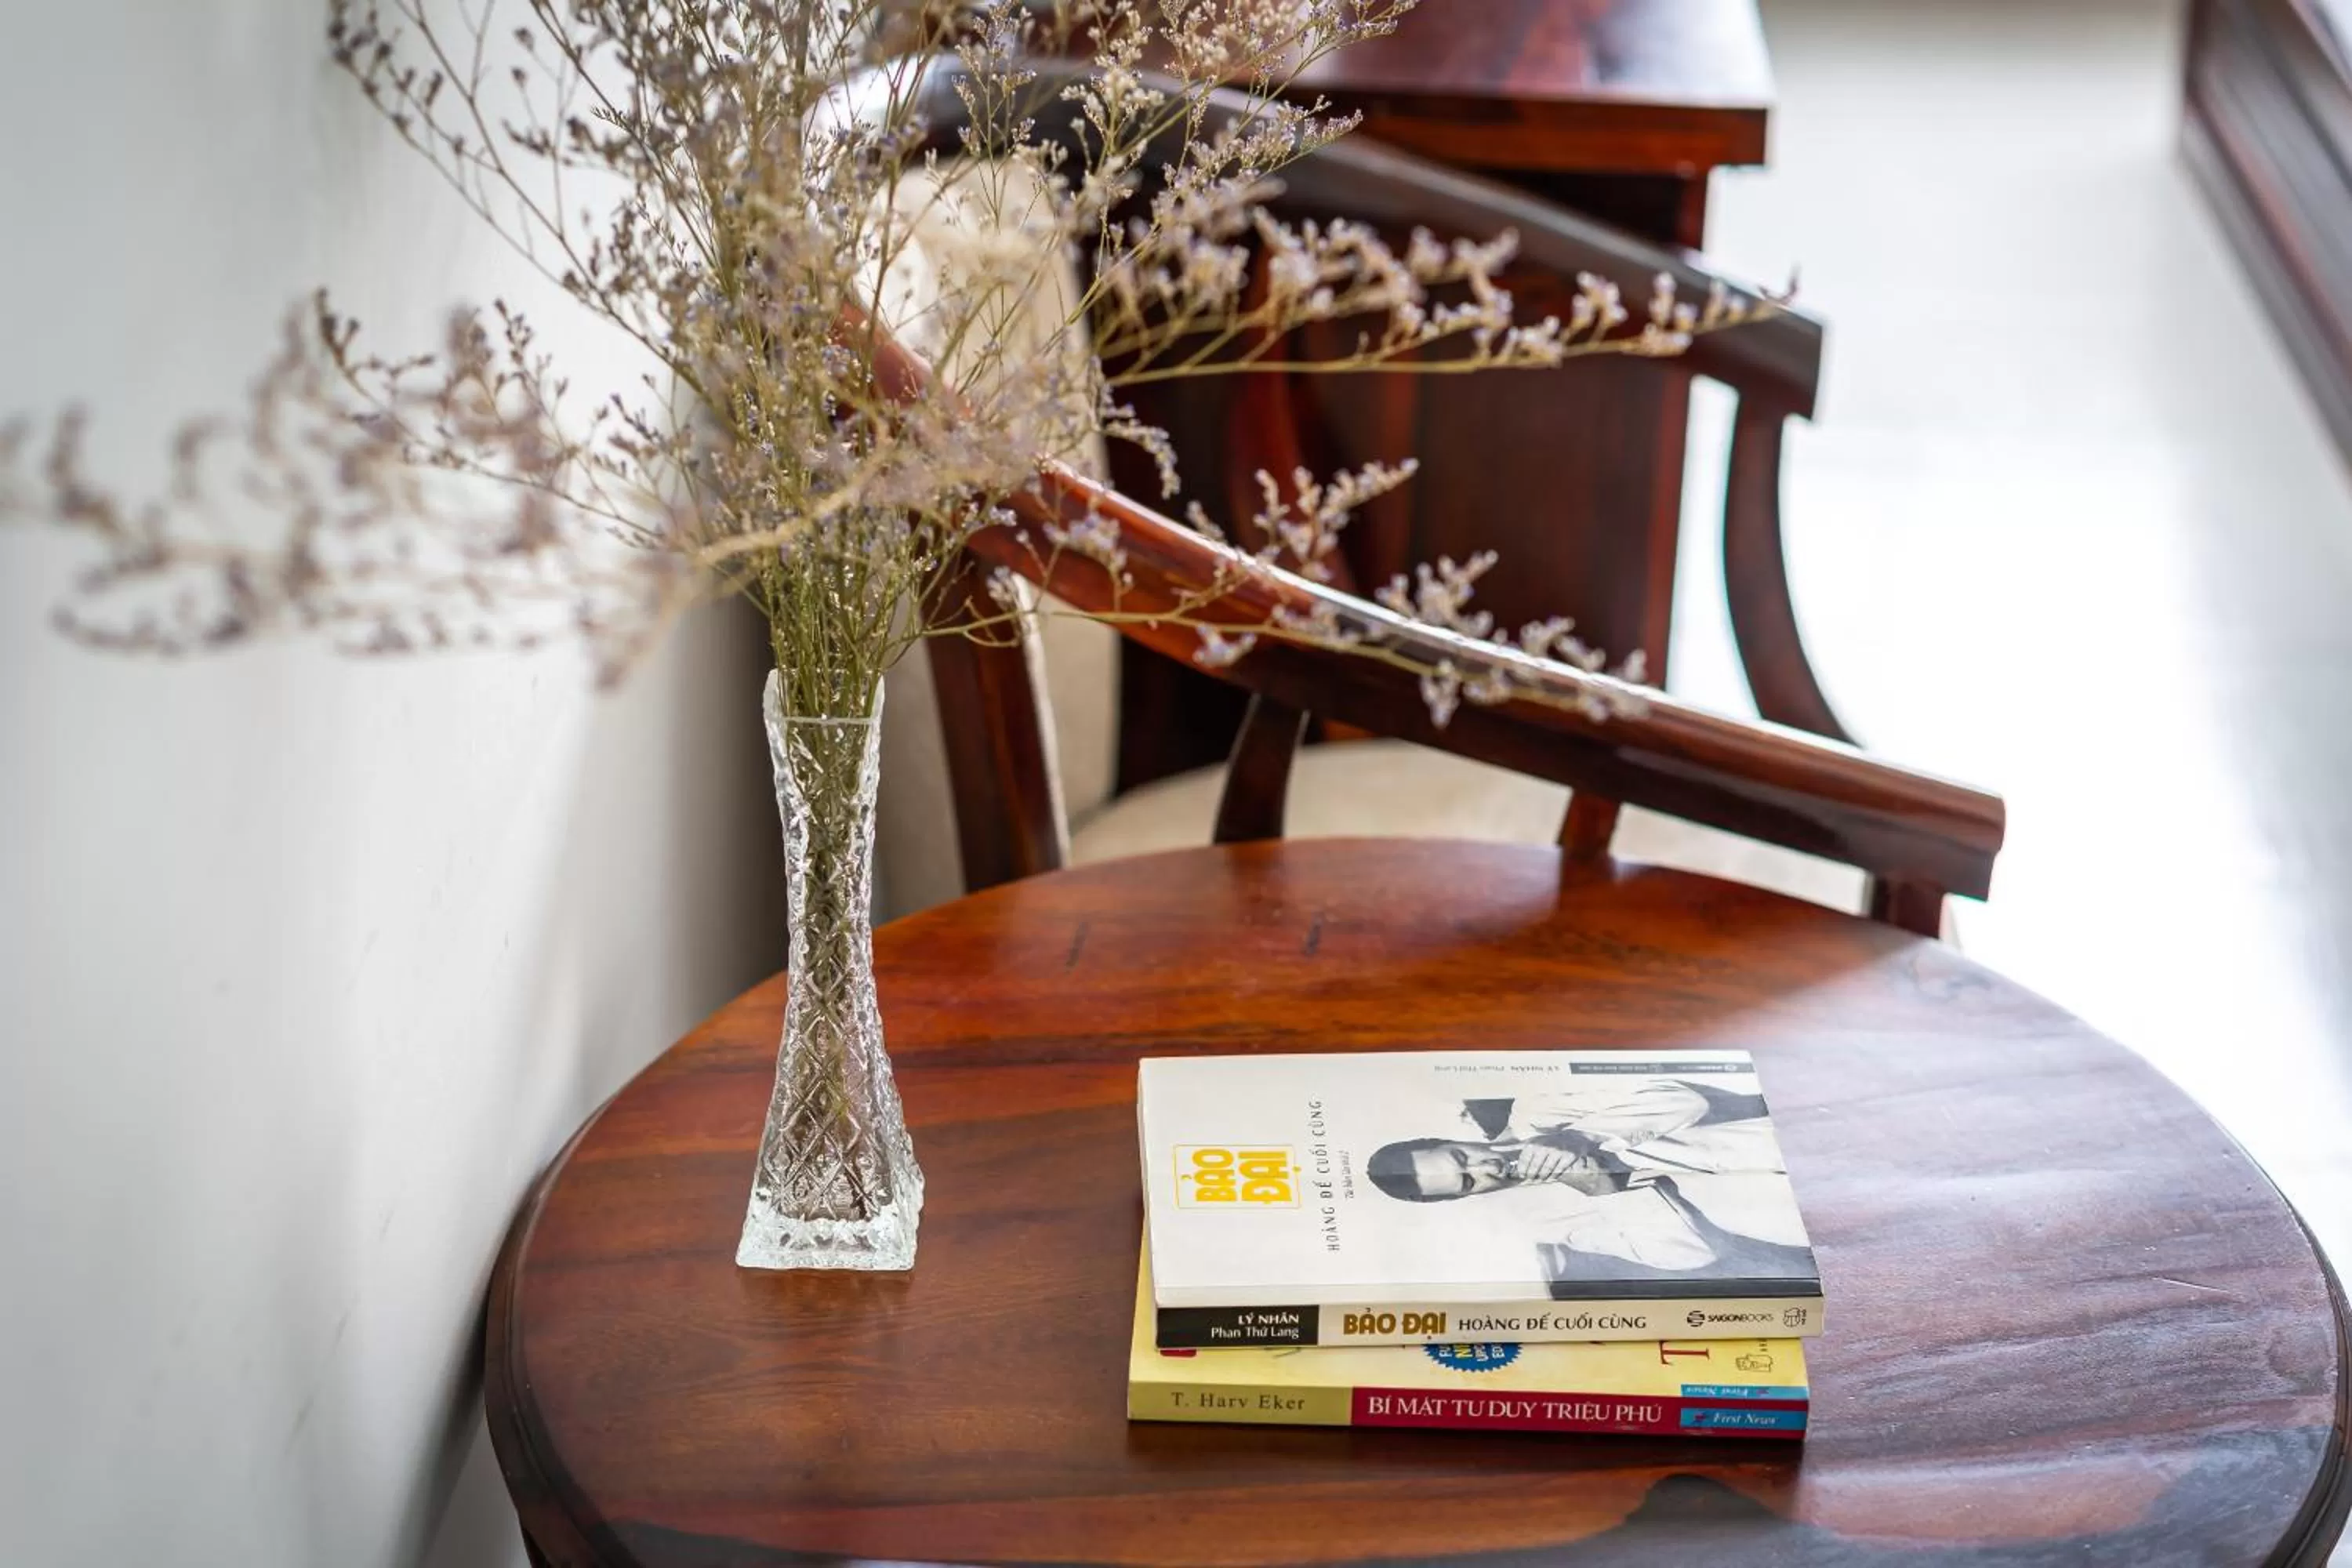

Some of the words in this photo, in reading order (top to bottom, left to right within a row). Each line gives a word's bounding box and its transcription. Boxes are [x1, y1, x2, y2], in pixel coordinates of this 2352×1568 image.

[1307, 1101, 1327, 1136] CÙNG
[1308, 1144, 1330, 1174] CUỐI
[1181, 1149, 1237, 1202] BẢO
[1238, 1151, 1301, 1204] ĐẠI
[1312, 1180, 1333, 1199] ĐẾ
[1321, 1207, 1341, 1250] HOÀNG
[1238, 1312, 1254, 1324] LÝ
[1343, 1307, 1396, 1335] BẢO
[1402, 1312, 1446, 1340] ĐẠI
[1458, 1315, 1520, 1330] HOÀNG
[1526, 1312, 1551, 1330] ĐẾ
[1554, 1312, 1592, 1330] CUỐI
[1598, 1313, 1646, 1329] CÙNG
[1707, 1313, 1774, 1323] SAIGONBOOKS
[1211, 1326, 1241, 1338] Phan
[1271, 1326, 1299, 1339] Lang
[1171, 1392, 1189, 1407] T.
[1200, 1393, 1249, 1409] Harv
[1258, 1394, 1305, 1410] Eker
[1367, 1395, 1392, 1414] BÍ
[1489, 1400, 1537, 1417] DUY
[1615, 1403, 1663, 1423] PHÚ
[1713, 1412, 1741, 1424] First
[1742, 1414, 1777, 1425] News
